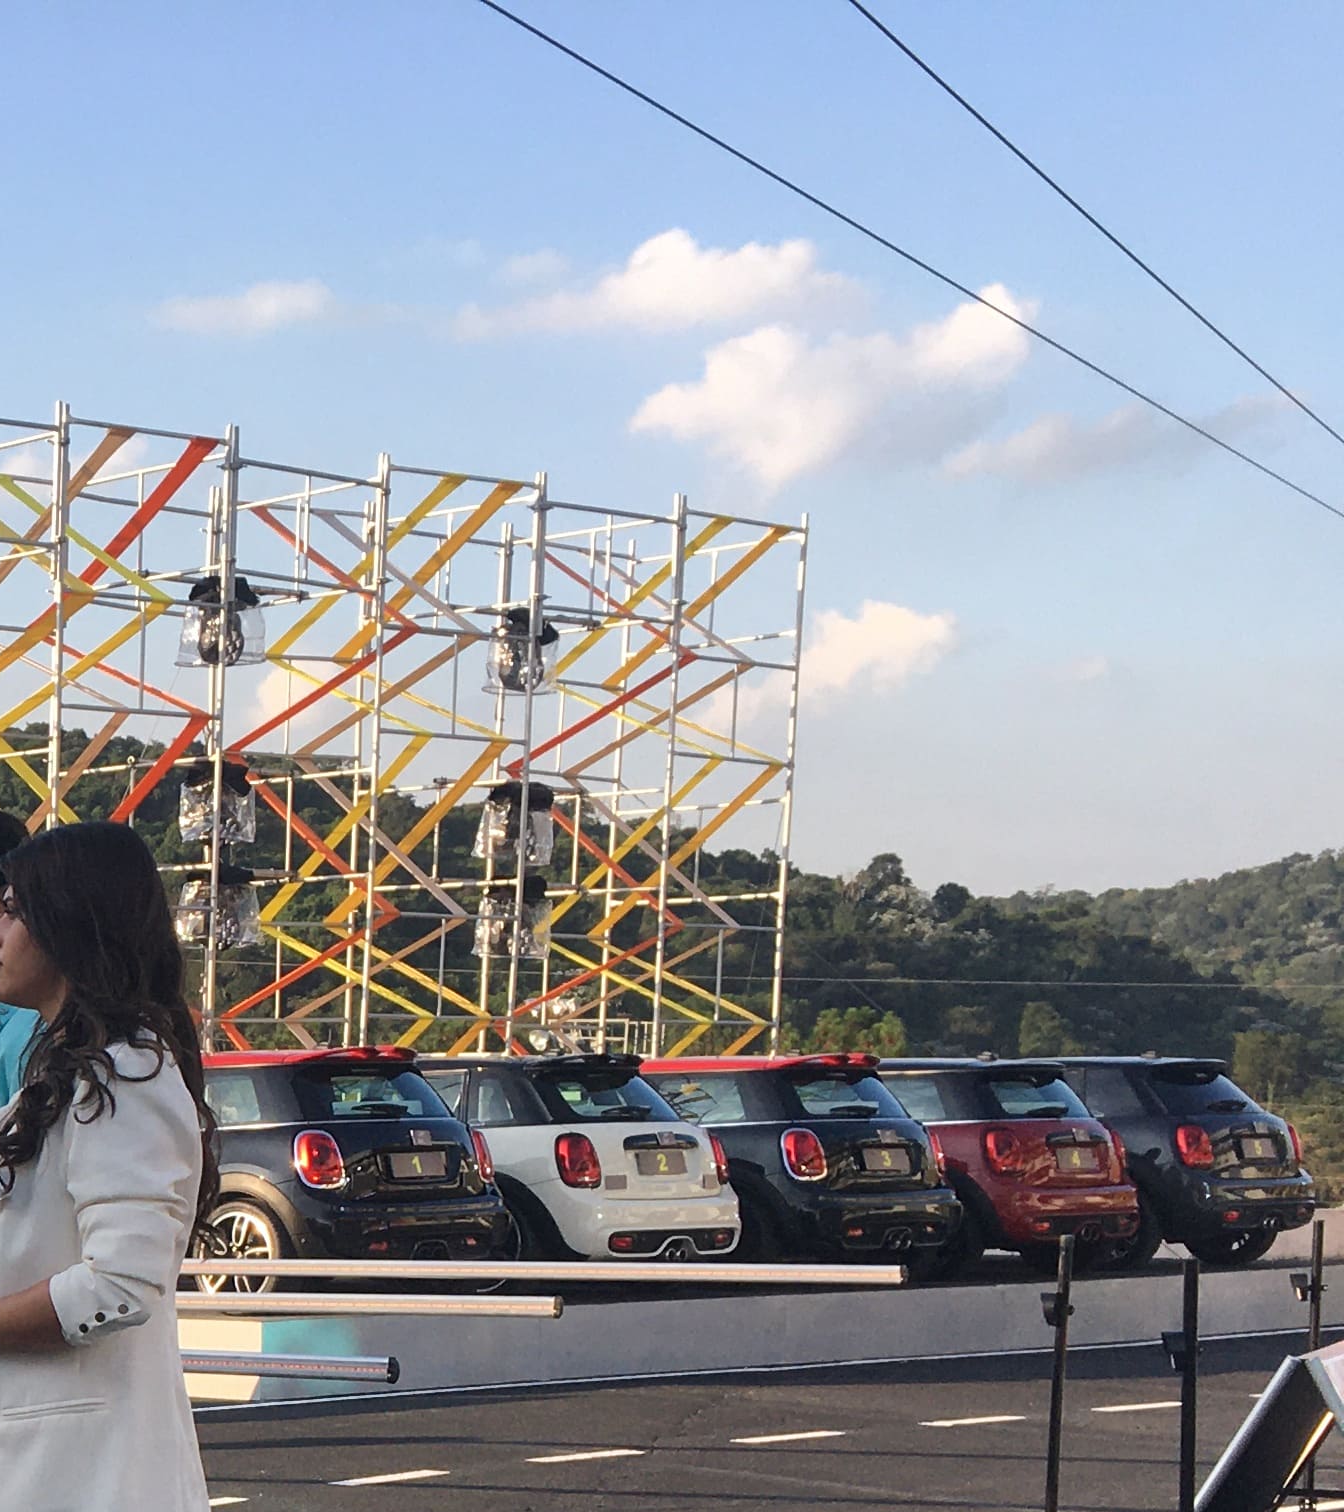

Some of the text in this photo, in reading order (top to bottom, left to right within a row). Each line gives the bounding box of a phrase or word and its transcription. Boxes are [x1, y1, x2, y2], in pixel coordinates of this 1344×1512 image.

[1253, 1139, 1263, 1156] 5
[411, 1154, 422, 1174] 1
[656, 1153, 669, 1172] 2
[880, 1150, 892, 1168] 3
[1072, 1150, 1081, 1168] 4
